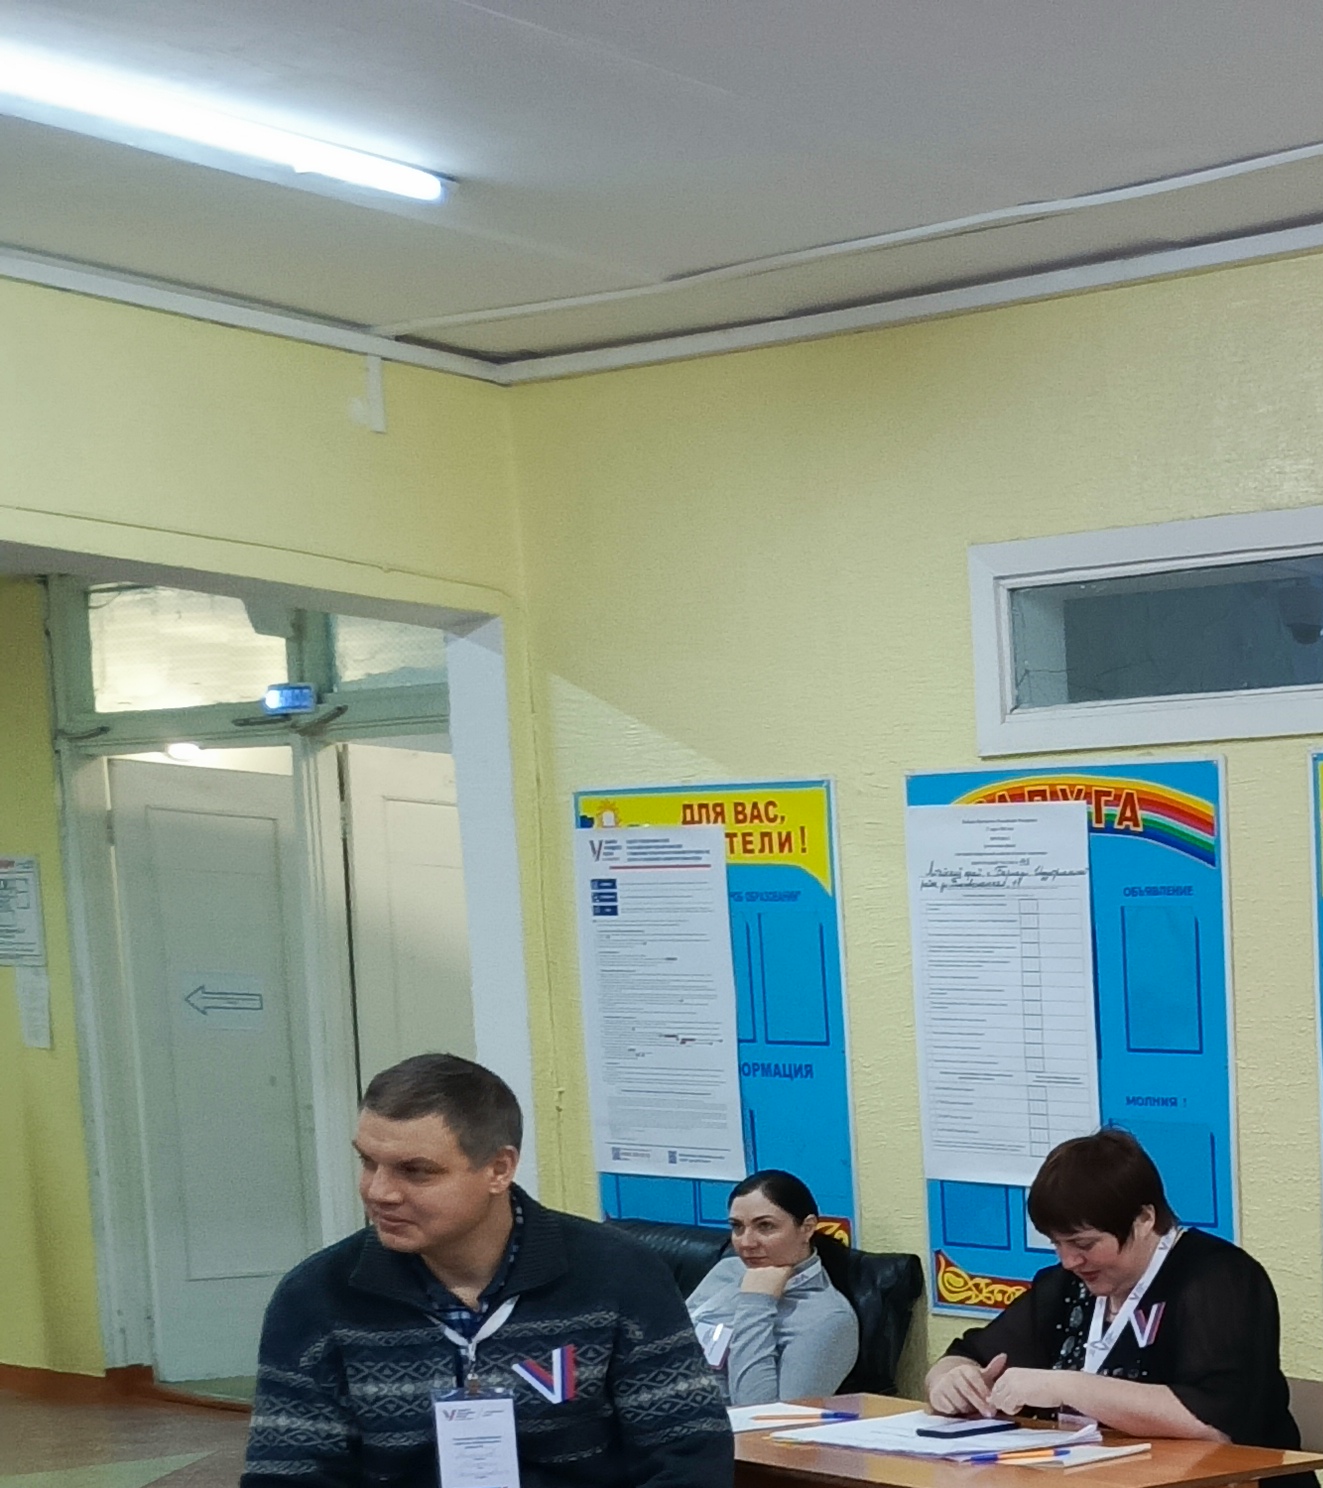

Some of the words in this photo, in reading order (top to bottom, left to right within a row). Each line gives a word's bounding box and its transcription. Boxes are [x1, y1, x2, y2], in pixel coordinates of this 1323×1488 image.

[682, 802, 726, 826] ДЛЯ
[733, 800, 786, 826] ВАС,
[725, 826, 807, 854] ТЕЛИ!
[741, 1062, 814, 1082] ОРМАЦИЯ
